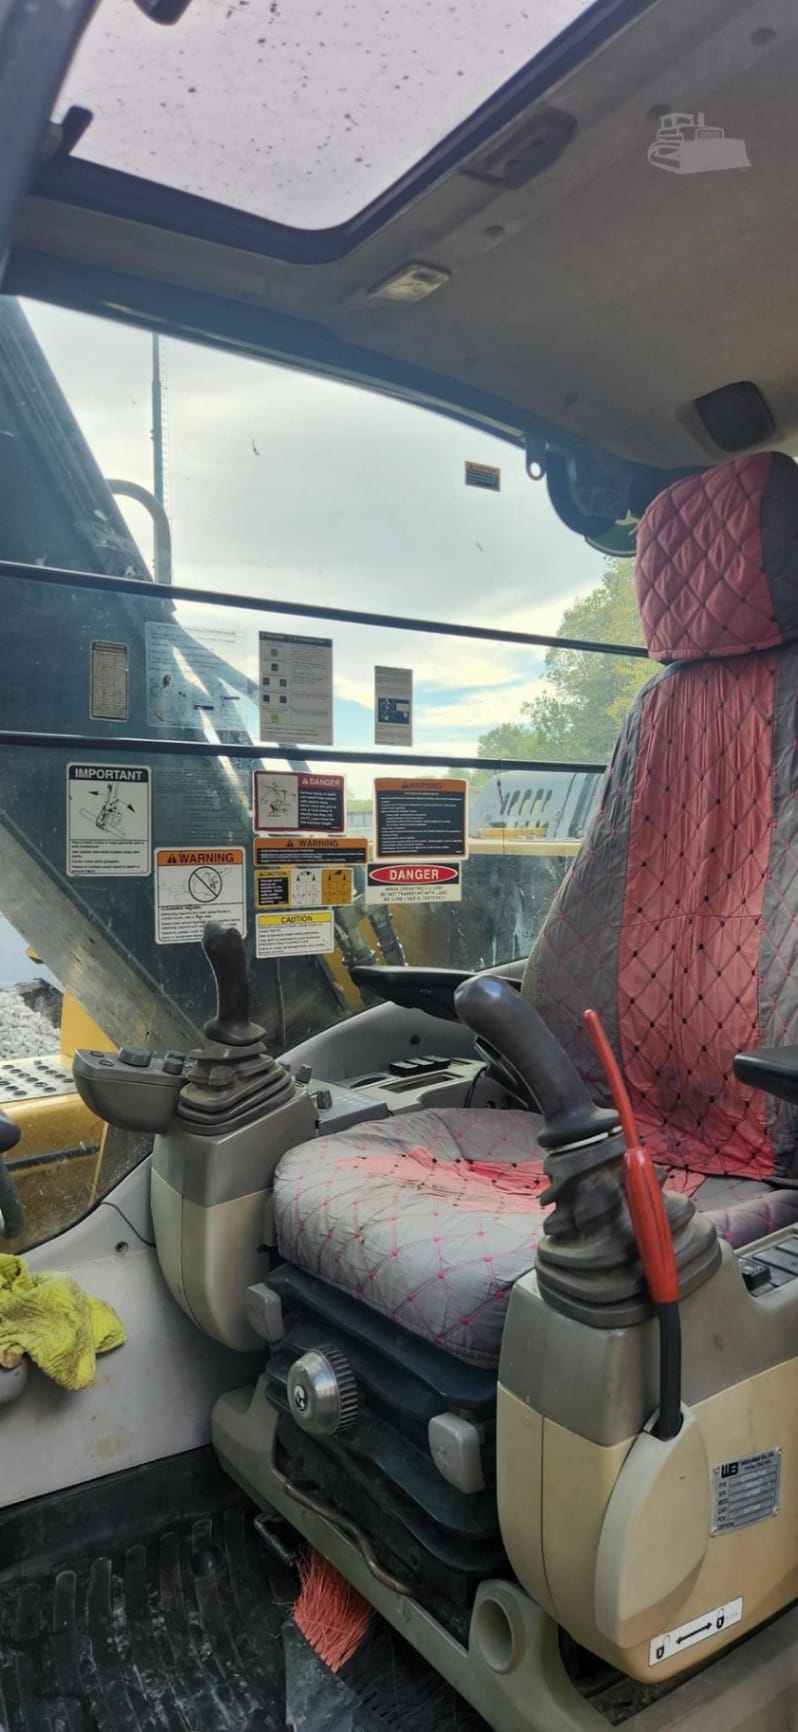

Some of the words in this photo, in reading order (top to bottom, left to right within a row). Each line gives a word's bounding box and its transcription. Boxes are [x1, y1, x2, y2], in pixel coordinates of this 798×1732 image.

[75, 767, 143, 780] IMPORTANT
[309, 777, 340, 787] DANGER
[298, 839, 339, 848] WARNING
[179, 852, 234, 864] WARNING
[389, 868, 439, 881] DANGER
[280, 915, 313, 924] CAUTION
